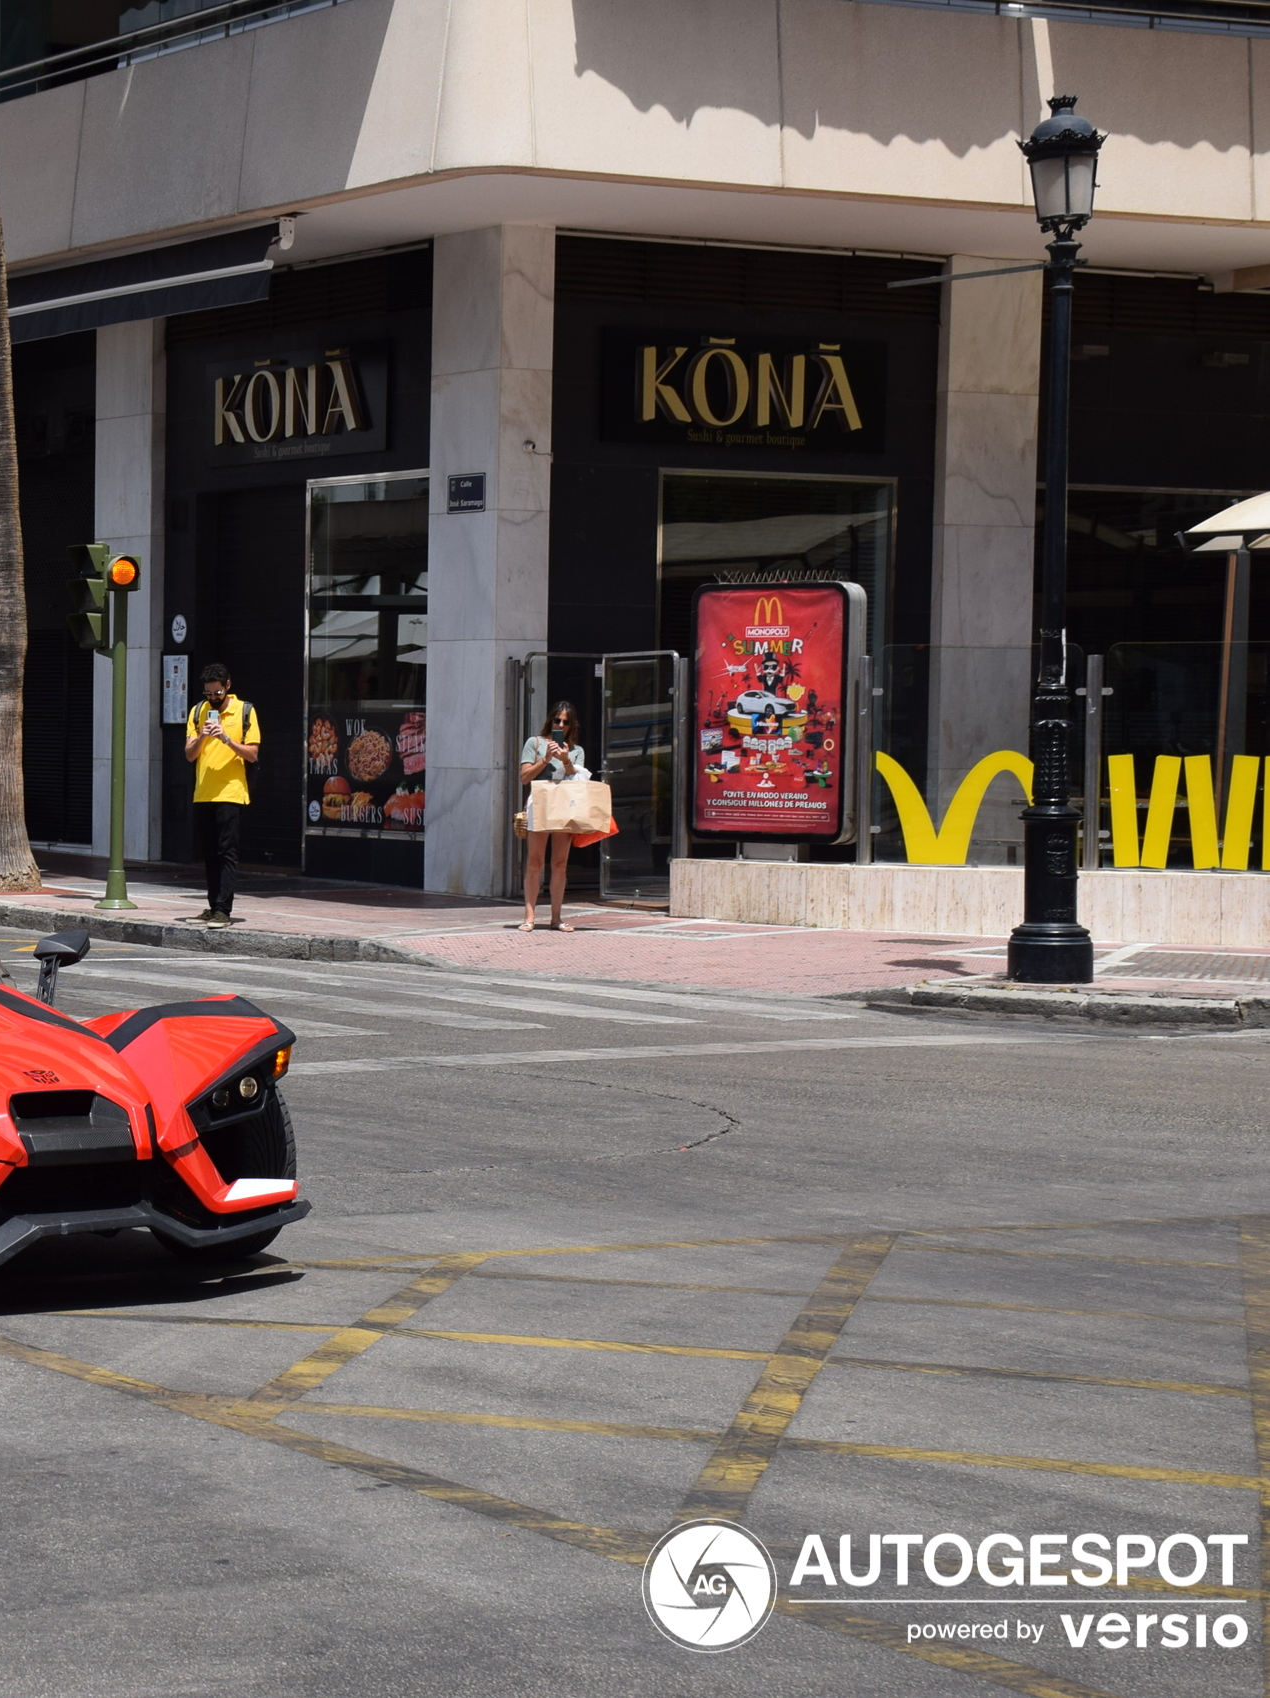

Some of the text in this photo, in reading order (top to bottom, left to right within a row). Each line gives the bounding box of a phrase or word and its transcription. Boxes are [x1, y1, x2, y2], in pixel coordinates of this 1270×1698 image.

[687, 429, 806, 449] Sushi & gourmet boutique
[253, 446, 272, 458] Sushi
[278, 443, 303, 459] gourmet
[304, 440, 331, 456] boutique
[460, 480, 472, 488] Calle
[747, 627, 789, 636] MONOPOLY
[733, 638, 804, 656] SUMMER
[345, 718, 366, 736] WOK
[309, 757, 338, 775] TAPAS
[712, 799, 748, 807] CONSIGUE
[748, 800, 783, 808] MILLONES
[795, 801, 827, 809] PREMIOS
[723, 790, 808, 800] PONTE EN MODO VERANO
[340, 804, 383, 824] BURGERS
